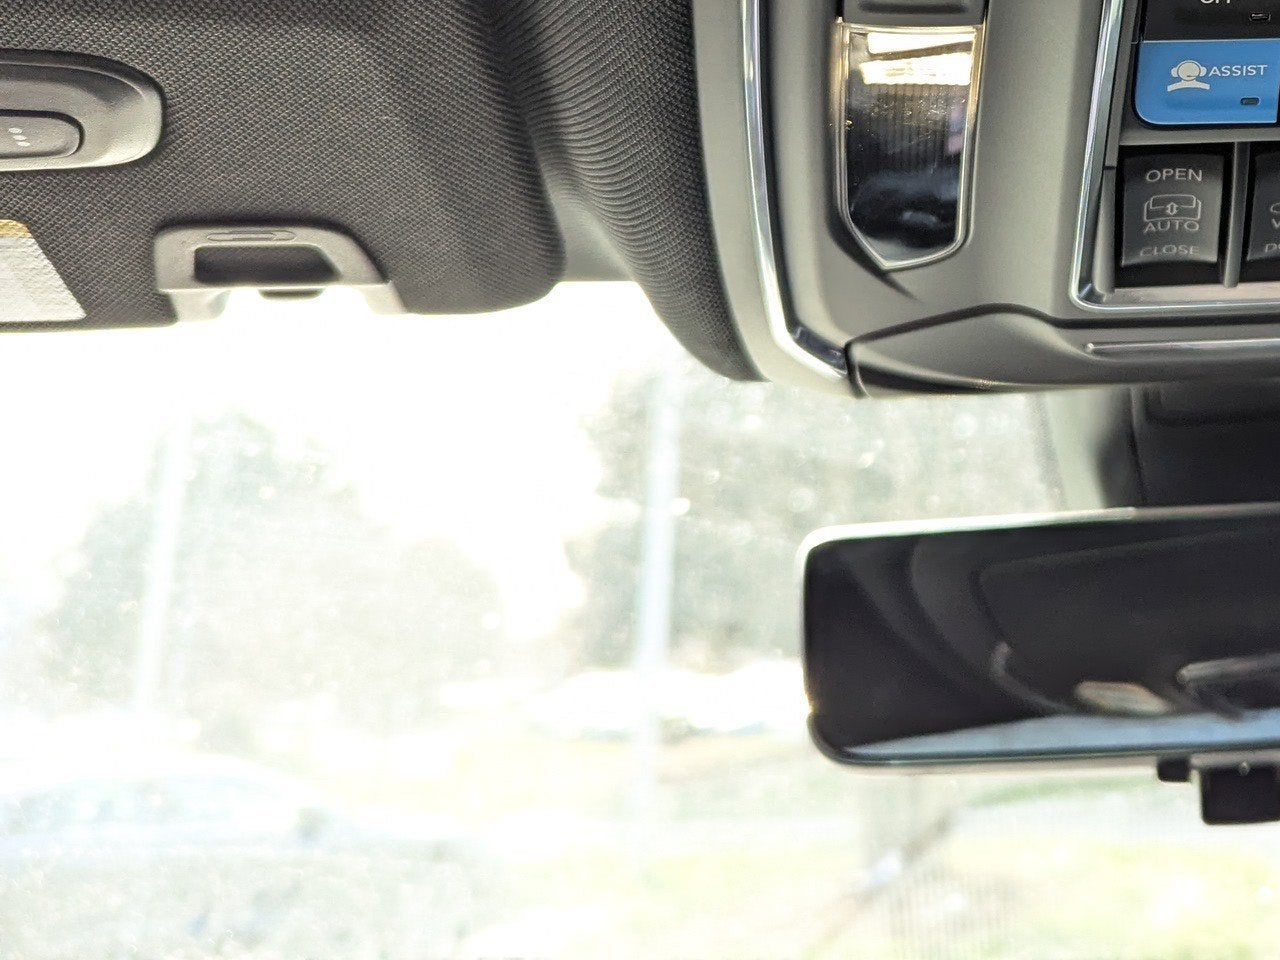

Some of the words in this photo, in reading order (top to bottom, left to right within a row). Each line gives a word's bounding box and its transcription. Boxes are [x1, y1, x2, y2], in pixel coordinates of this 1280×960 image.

[1208, 64, 1268, 77] ASSIST
[1145, 167, 1203, 182] OPEN
[1143, 220, 1200, 234] AUTO
[1139, 244, 1200, 257] CLOSE
